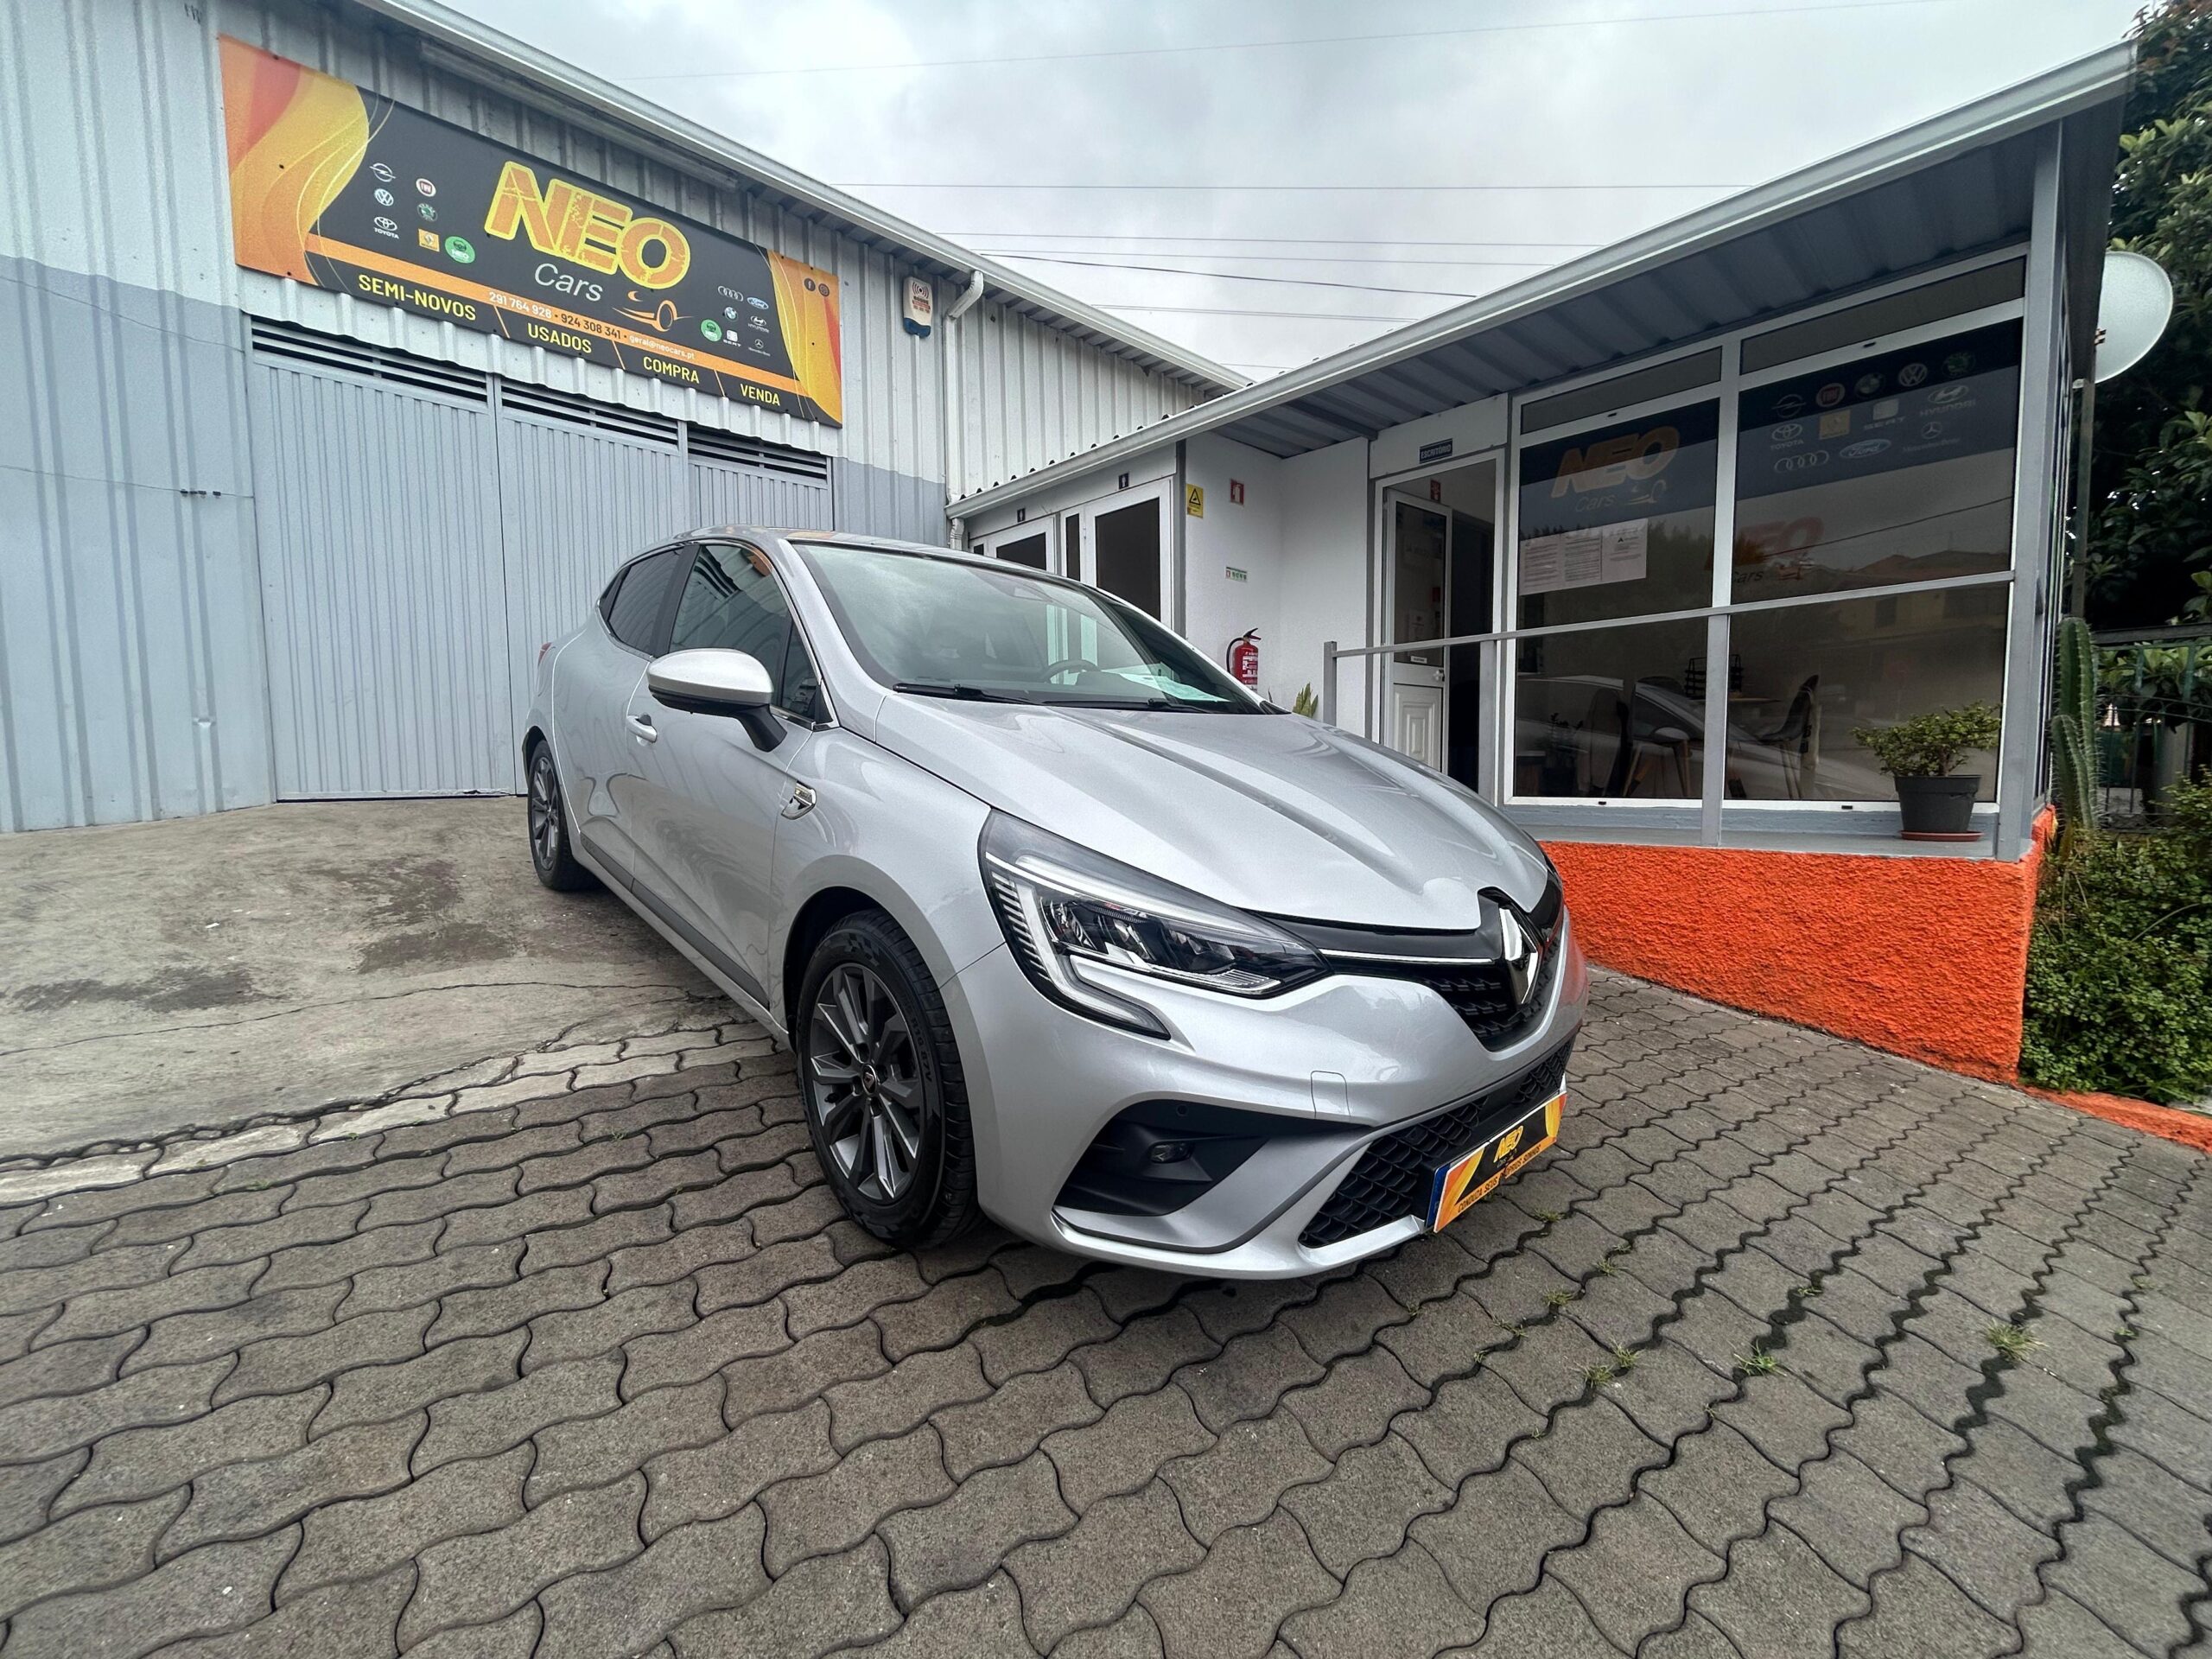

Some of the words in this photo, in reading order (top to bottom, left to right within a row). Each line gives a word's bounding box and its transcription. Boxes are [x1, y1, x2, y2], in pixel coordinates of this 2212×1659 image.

[373, 227, 399, 239] TOYOTA
[485, 161, 690, 289] NEO
[534, 263, 603, 302] Cars
[358, 274, 476, 321] SEMI-NOVOS
[489, 292, 508, 305] 291
[510, 297, 530, 313] 764
[531, 304, 552, 319] 928
[561, 313, 582, 327] 924
[582, 319, 602, 334] 308
[604, 325, 621, 339] 341
[629, 334, 695, 360] geral@neocars.pt
[528, 322, 592, 353] USADOS
[643, 356, 700, 384] COMPRA
[740, 383, 780, 406] VENDA
[1919, 398, 1976, 417] HYUNDAI
[1862, 416, 1906, 431] SEAT
[1770, 439, 1804, 450] TOYOTA
[1847, 440, 1883, 456] Ford
[1551, 425, 1681, 499] NEO
[1575, 494, 1616, 512] Cars
[1493, 1125, 1523, 1163] NEO
